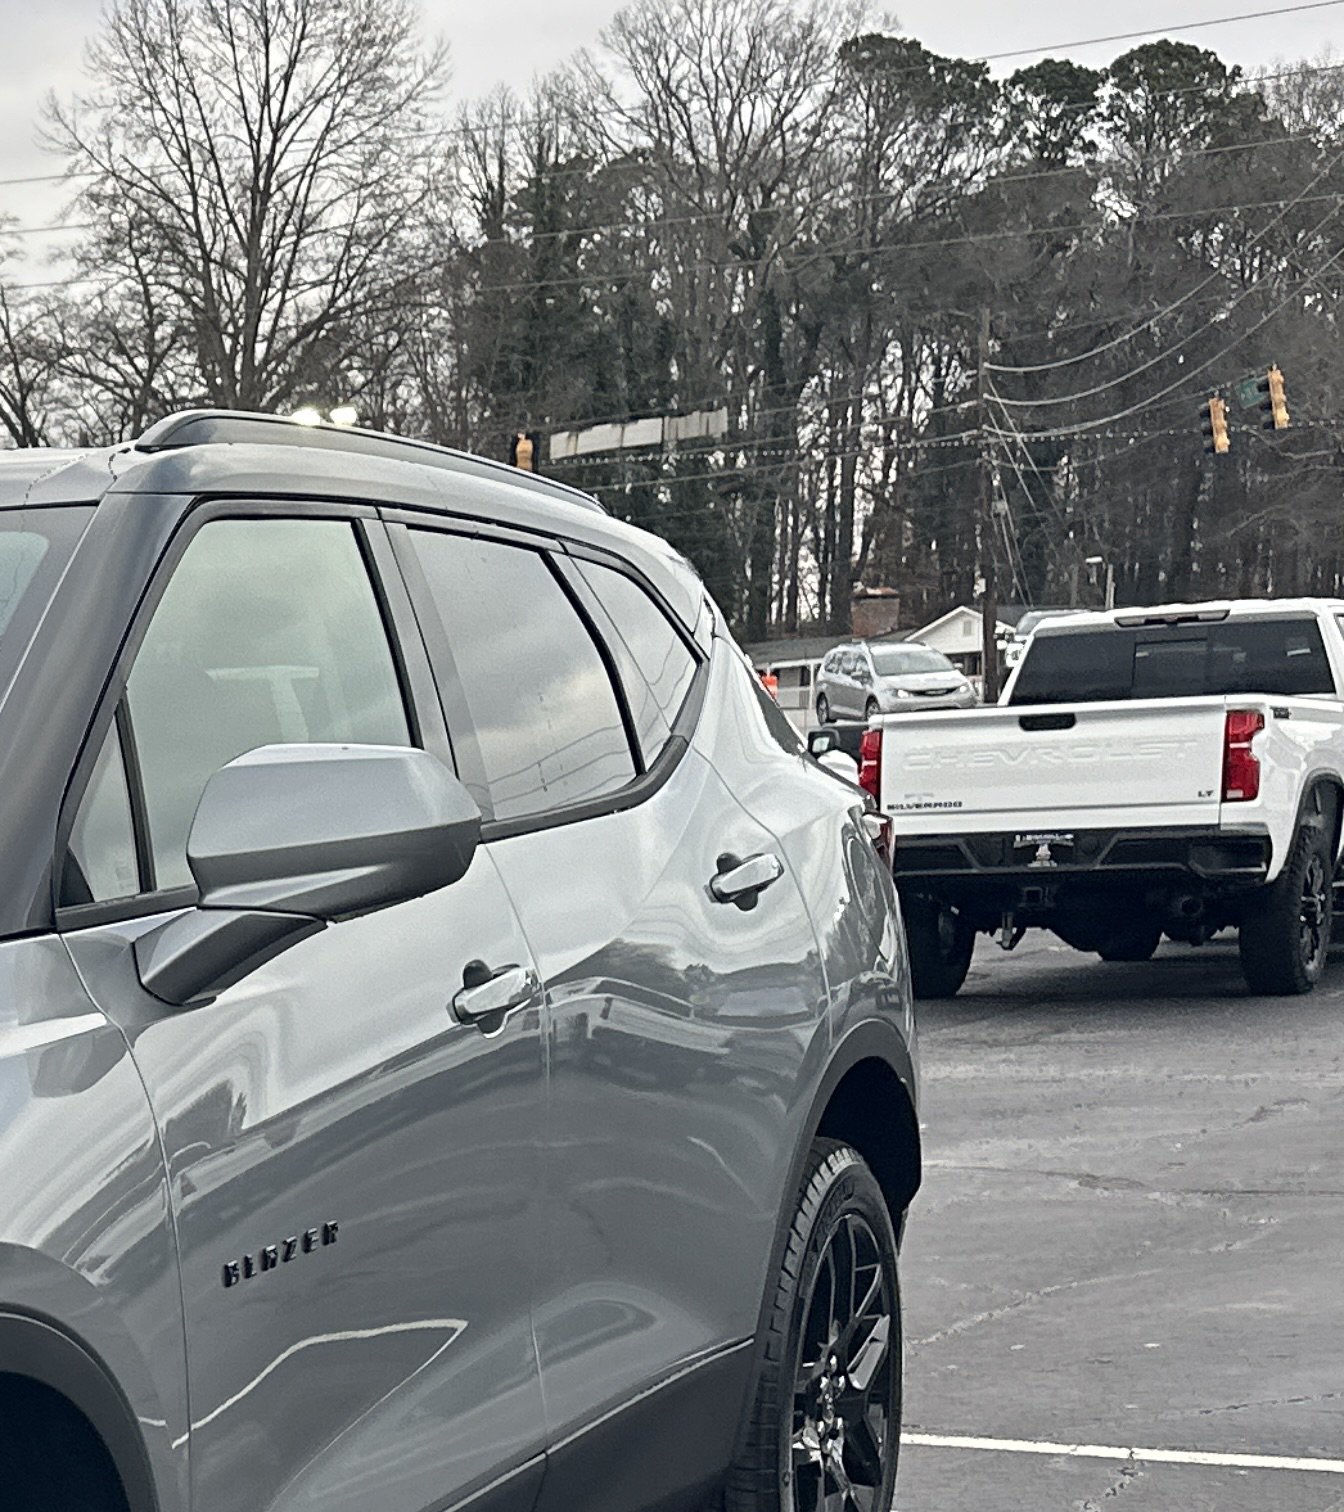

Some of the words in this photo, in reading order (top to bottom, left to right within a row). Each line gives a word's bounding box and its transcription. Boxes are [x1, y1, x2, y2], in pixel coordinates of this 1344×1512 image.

[902, 738, 1198, 771] CHEVROLET
[1197, 789, 1214, 799] LT
[222, 1219, 340, 1288] BLAZER
